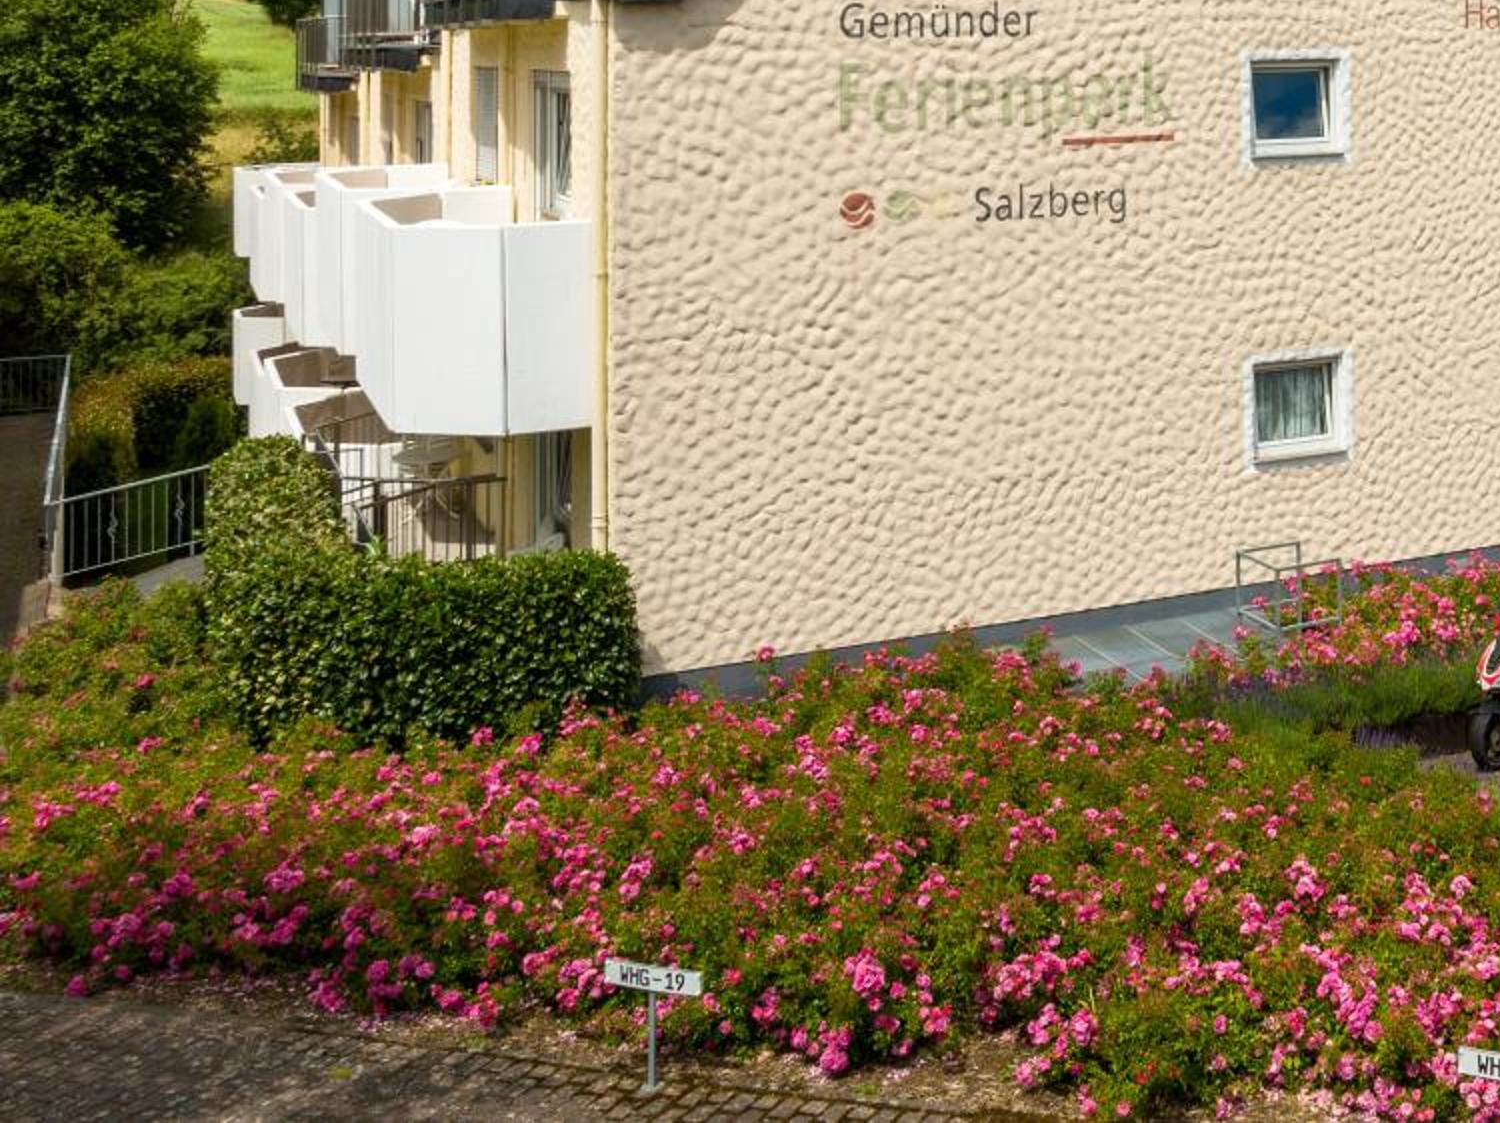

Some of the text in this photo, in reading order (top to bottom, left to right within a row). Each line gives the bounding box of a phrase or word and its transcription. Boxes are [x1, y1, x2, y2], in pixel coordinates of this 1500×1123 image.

[839, 1, 1038, 39] Gemünder
[837, 52, 1174, 142] Ferienpark
[974, 184, 1127, 224] Salzberg
[619, 964, 685, 991] WHG-19
